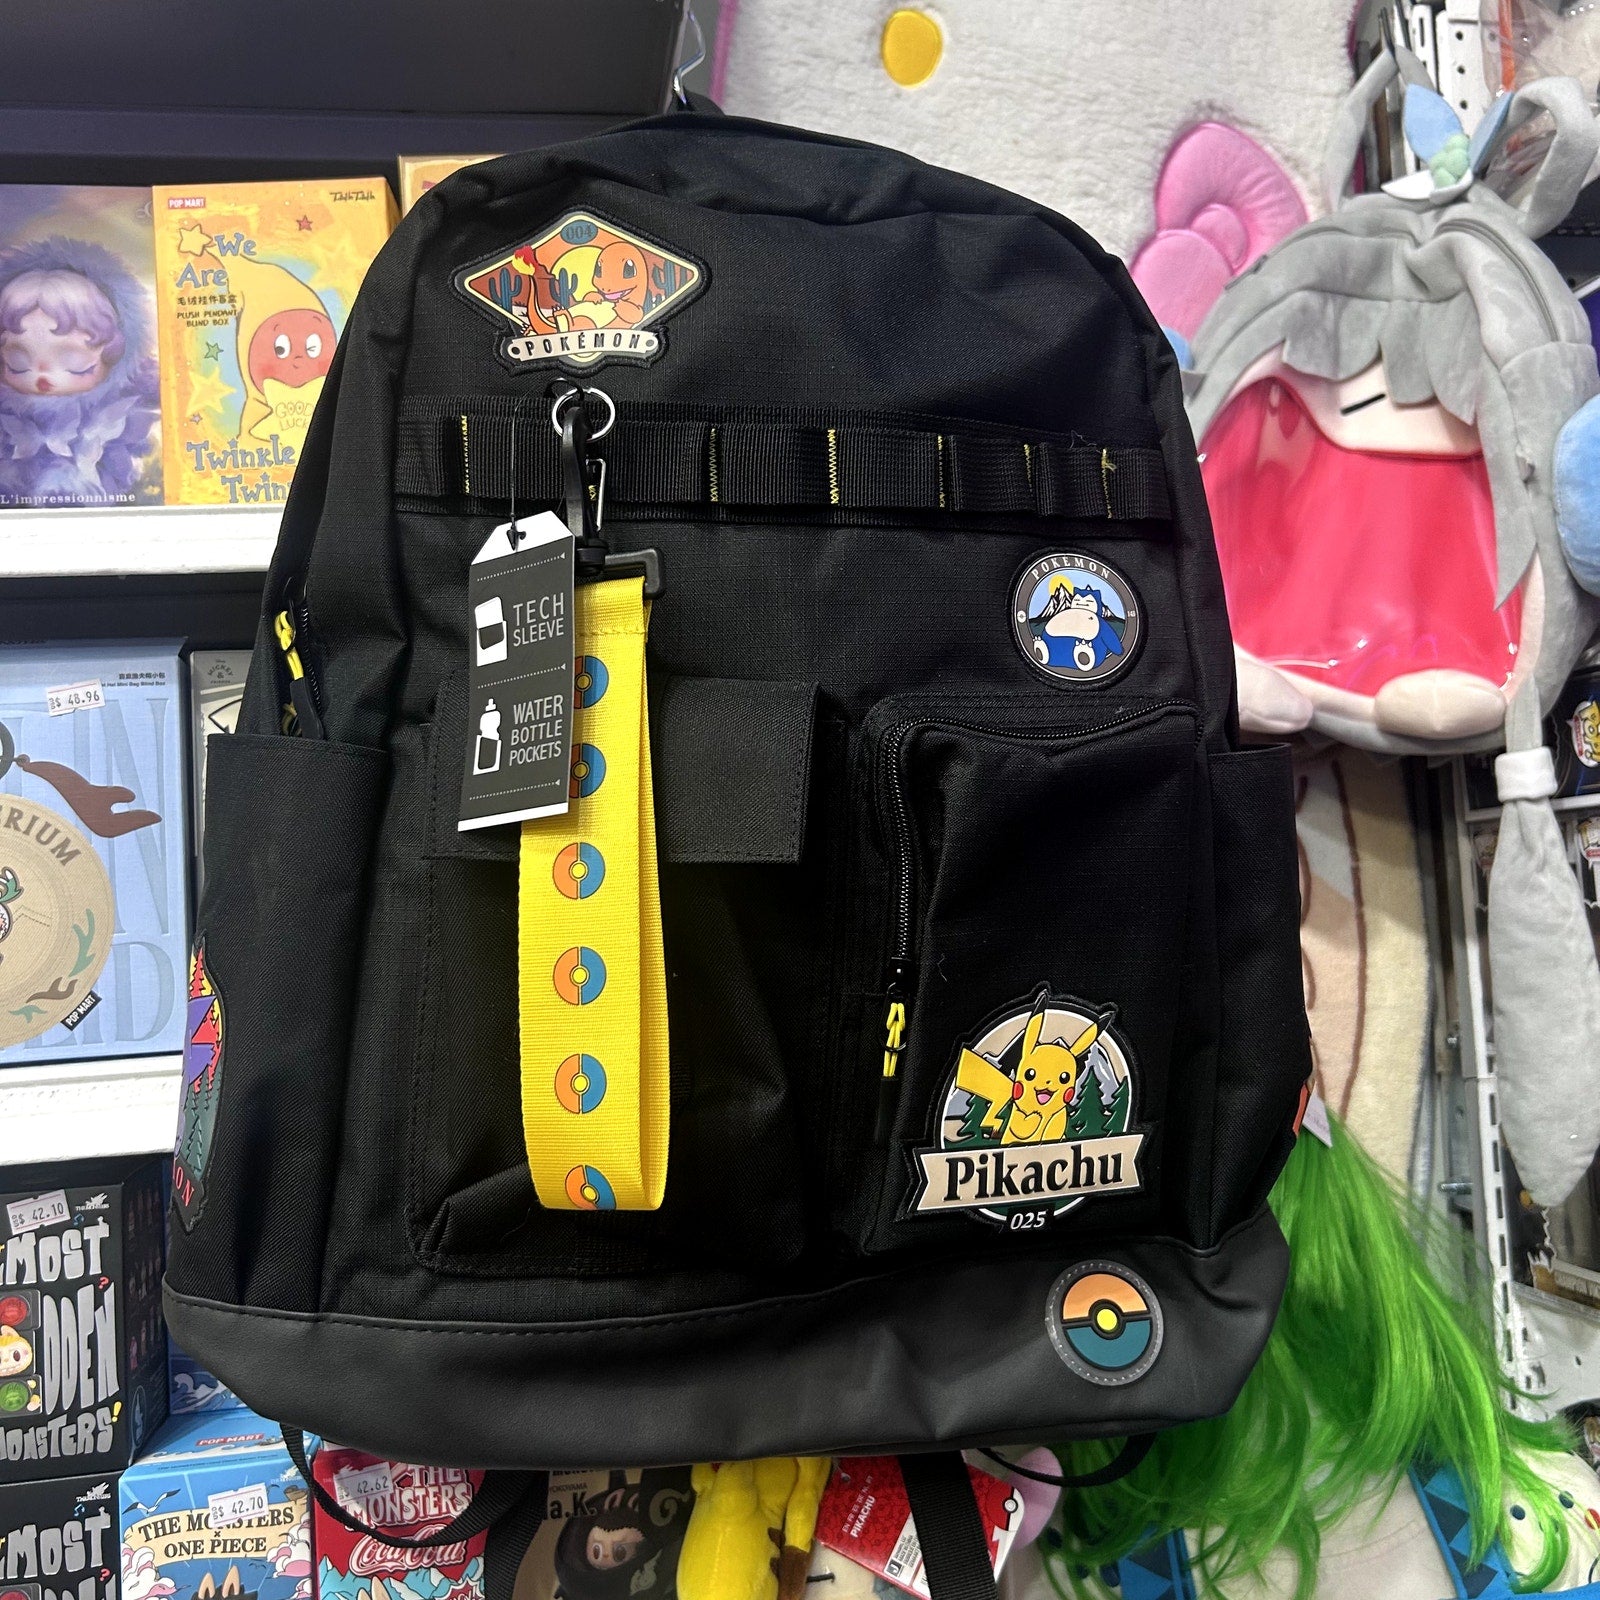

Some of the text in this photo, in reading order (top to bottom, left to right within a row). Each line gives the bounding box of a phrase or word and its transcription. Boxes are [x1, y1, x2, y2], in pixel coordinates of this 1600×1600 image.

[169, 198, 205, 208] POP MART
[214, 232, 257, 256] We
[565, 223, 593, 241] 004
[175, 262, 228, 288] Are
[176, 309, 237, 319] PLUSH PENDANT
[212, 318, 229, 326] BOX
[525, 332, 641, 357] POKÉMON
[186, 434, 296, 471] Twinkle
[221, 472, 292, 503] Twin
[513, 592, 564, 626] TECH
[513, 617, 564, 647] SLEEVE
[68, 690, 100, 706] 48.96
[513, 694, 564, 725] WATER
[511, 719, 563, 746] BOTTLE
[509, 740, 562, 767] POCKETS
[0, 804, 81, 866] RIUM
[65, 994, 96, 1026] POP MART
[943, 1144, 1123, 1202] Pikachu
[32, 1202, 64, 1221] 42.10
[1010, 1211, 1048, 1230] 025
[0, 1216, 110, 1285] MOST
[199, 1433, 262, 1446] POP MART
[357, 1475, 389, 1494] 42.62
[408, 1464, 465, 1487] THE
[231, 1496, 264, 1515] 42.70
[850, 1495, 876, 1538] PIKACHU
[138, 1516, 181, 1542] THE
[0, 1506, 111, 1580] MOST
[164, 1537, 267, 1558] ONE PIECE
